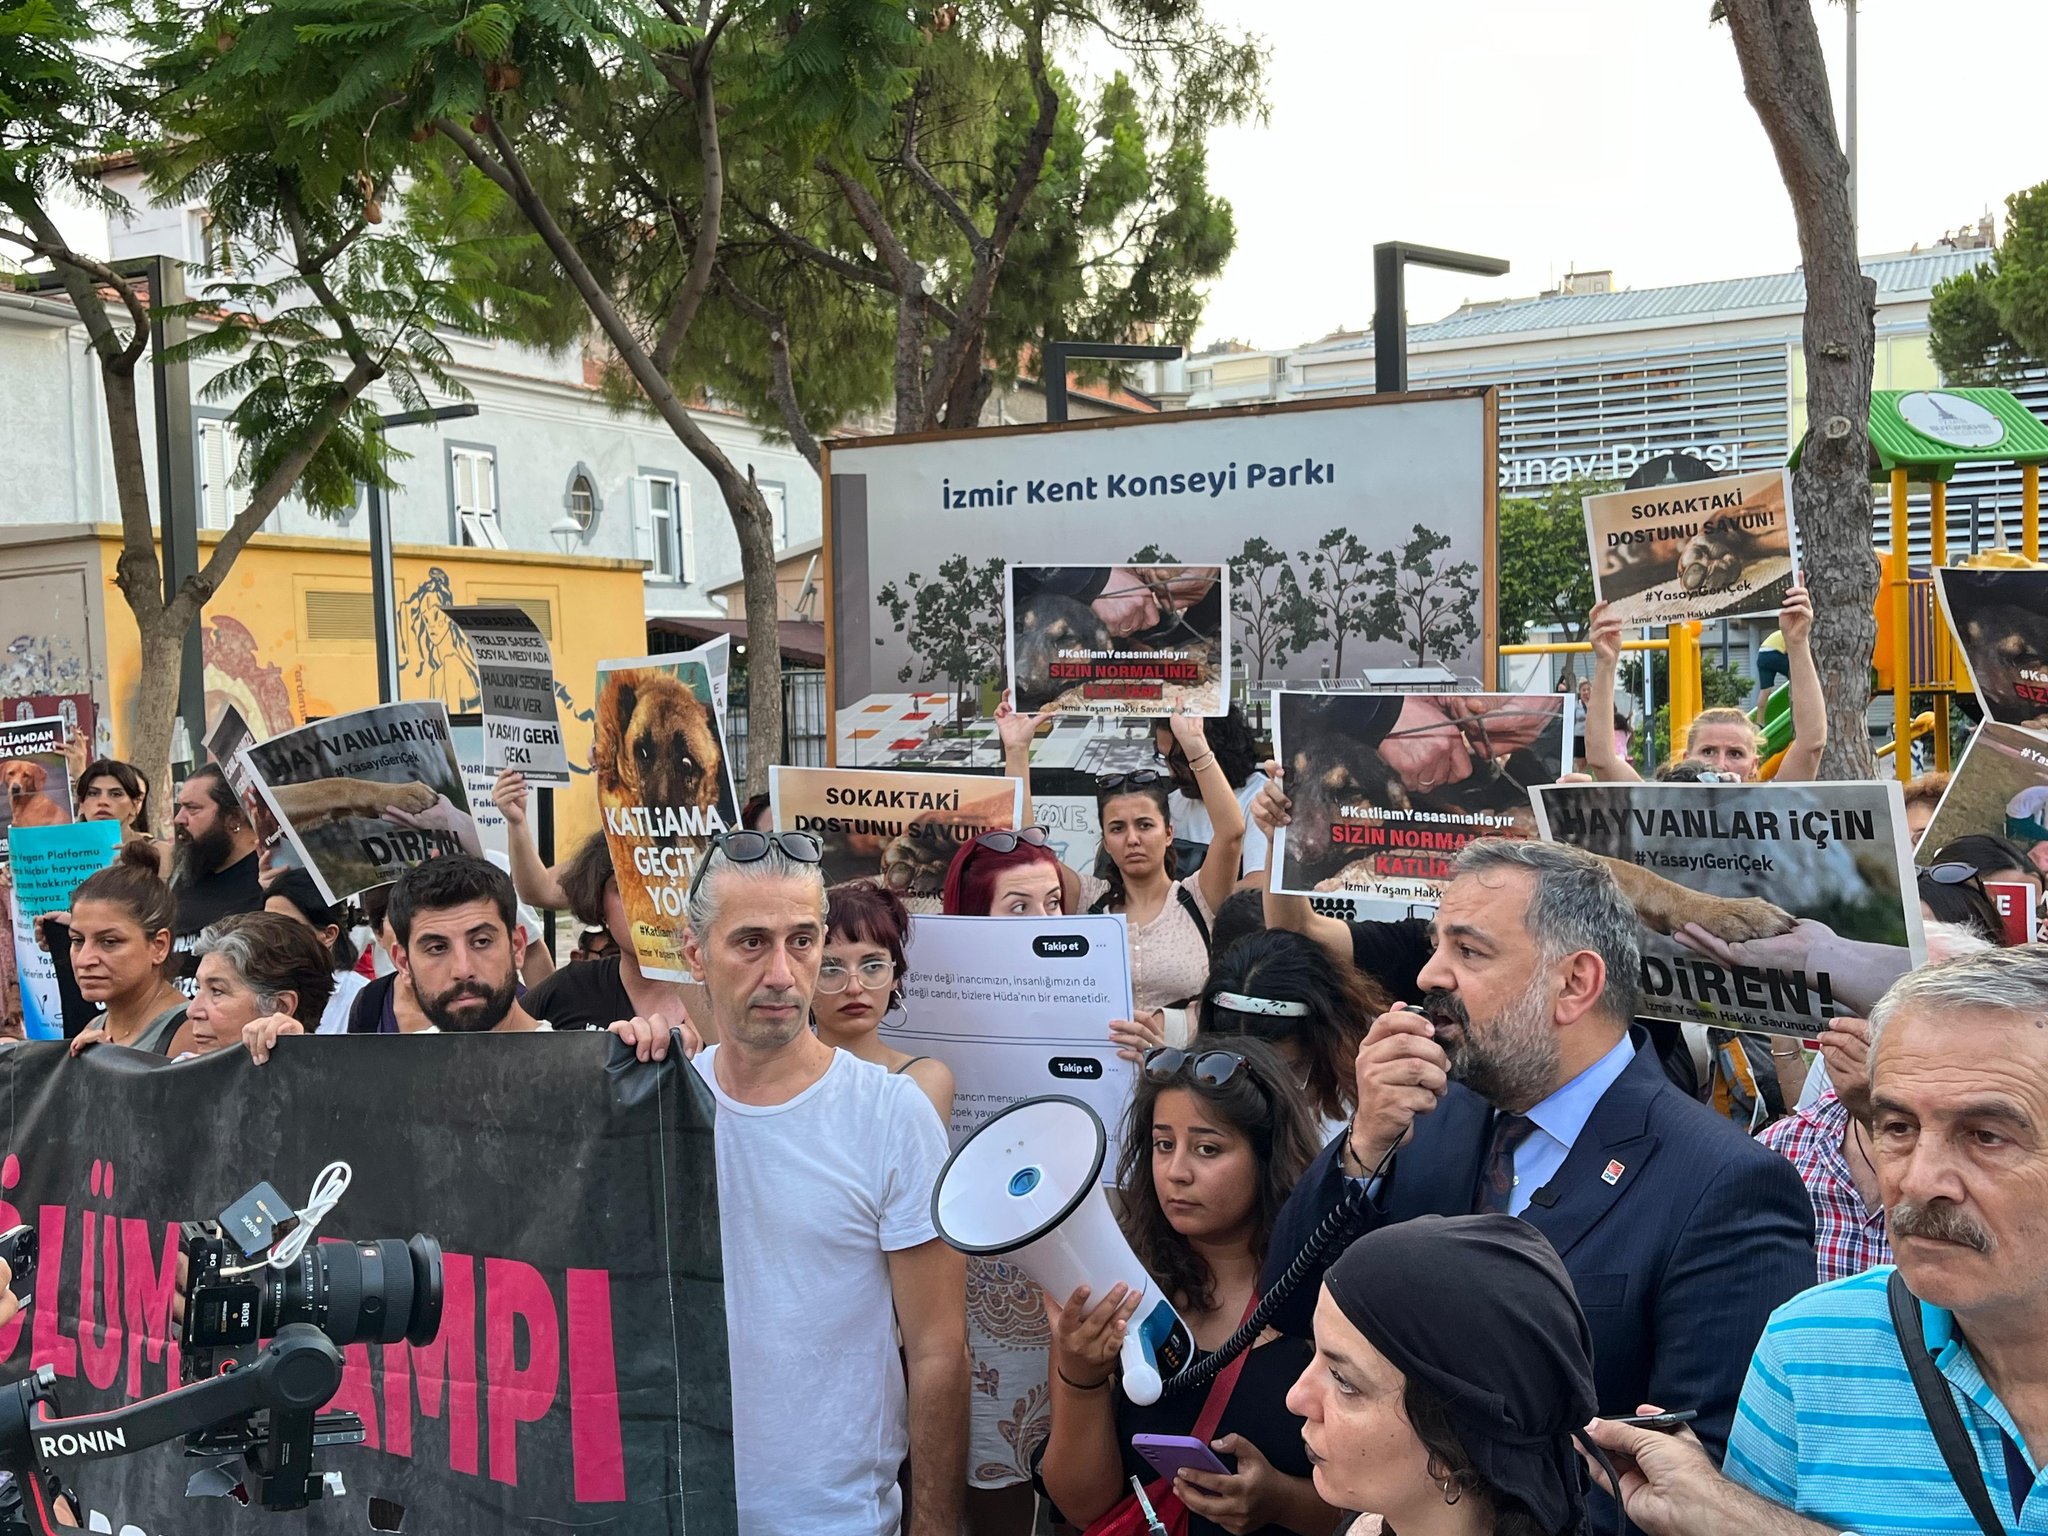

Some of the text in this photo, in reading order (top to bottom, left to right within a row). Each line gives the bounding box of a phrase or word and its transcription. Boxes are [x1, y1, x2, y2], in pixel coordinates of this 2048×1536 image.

[943, 458, 1335, 509] İzmir Kent Konseyi Parkı
[1631, 487, 1744, 520] SOKAKTAKİ
[1607, 511, 1775, 547] DOSTUNU SAVUN!
[472, 635, 543, 648] TROLLER SADECE
[476, 649, 550, 664] SOSYAL MEDYADA
[482, 672, 518, 688] HALKIN
[493, 694, 542, 713] KULAK VER
[488, 722, 560, 744] YASAYI GERİ
[268, 723, 416, 778] HAYVANLAR
[504, 746, 531, 766] ÇEK!
[826, 788, 959, 811] SOKAKTAKİ
[795, 815, 902, 836] DOSTUNU
[1332, 823, 1385, 845] SİZİN
[1562, 808, 1782, 840] HAYVANLAR
[47, 848, 100, 861] Platformu
[1635, 850, 1774, 876] #YasayıGeriÇek
[52, 863, 103, 875] hayvanın
[1375, 884, 1411, 898] Yaşam
[1042, 941, 1079, 952] Takip et
[910, 974, 933, 984] görev
[934, 973, 955, 985] değil
[1083, 975, 1096, 986] da
[962, 990, 992, 1001] bizlere
[1038, 992, 1050, 1002] bir
[1053, 993, 1111, 1004] emanetidir.
[1675, 1003, 1717, 1020] Yaşam
[1720, 1009, 1757, 1025] Hakkı
[1058, 1062, 1093, 1074] Takip et
[39, 1426, 127, 1459] RONIN
